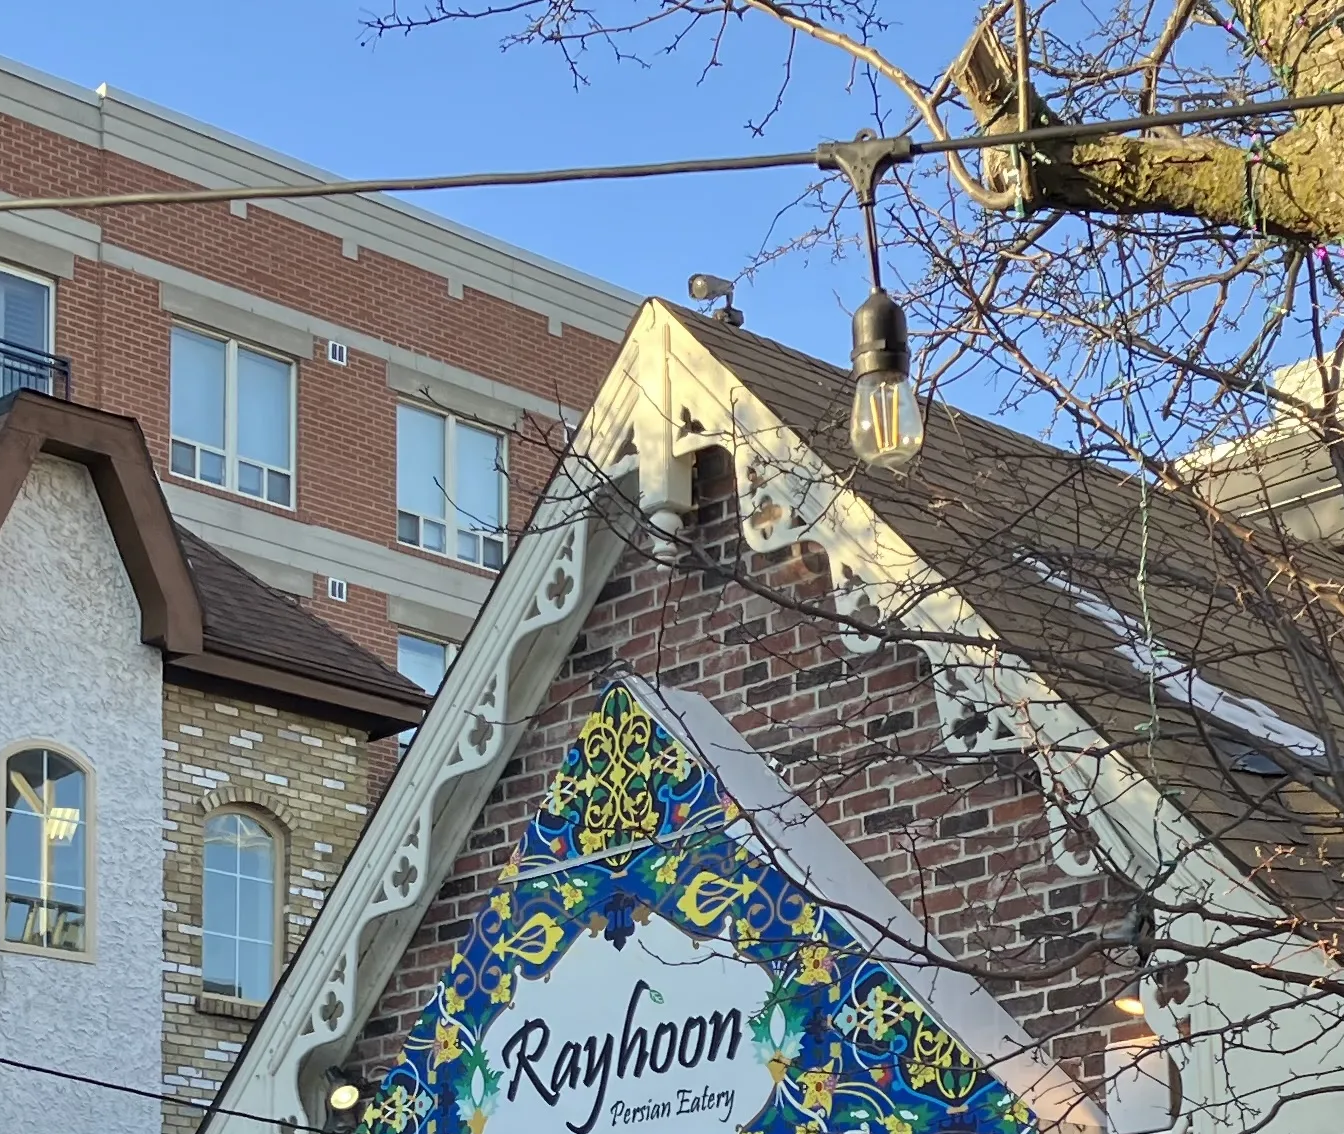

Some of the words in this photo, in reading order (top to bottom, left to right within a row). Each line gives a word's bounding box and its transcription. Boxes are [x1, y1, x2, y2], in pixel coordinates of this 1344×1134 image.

[502, 979, 742, 1134] Rayhoon
[610, 1098, 672, 1127] Persian
[676, 1085, 736, 1123] Eatery
